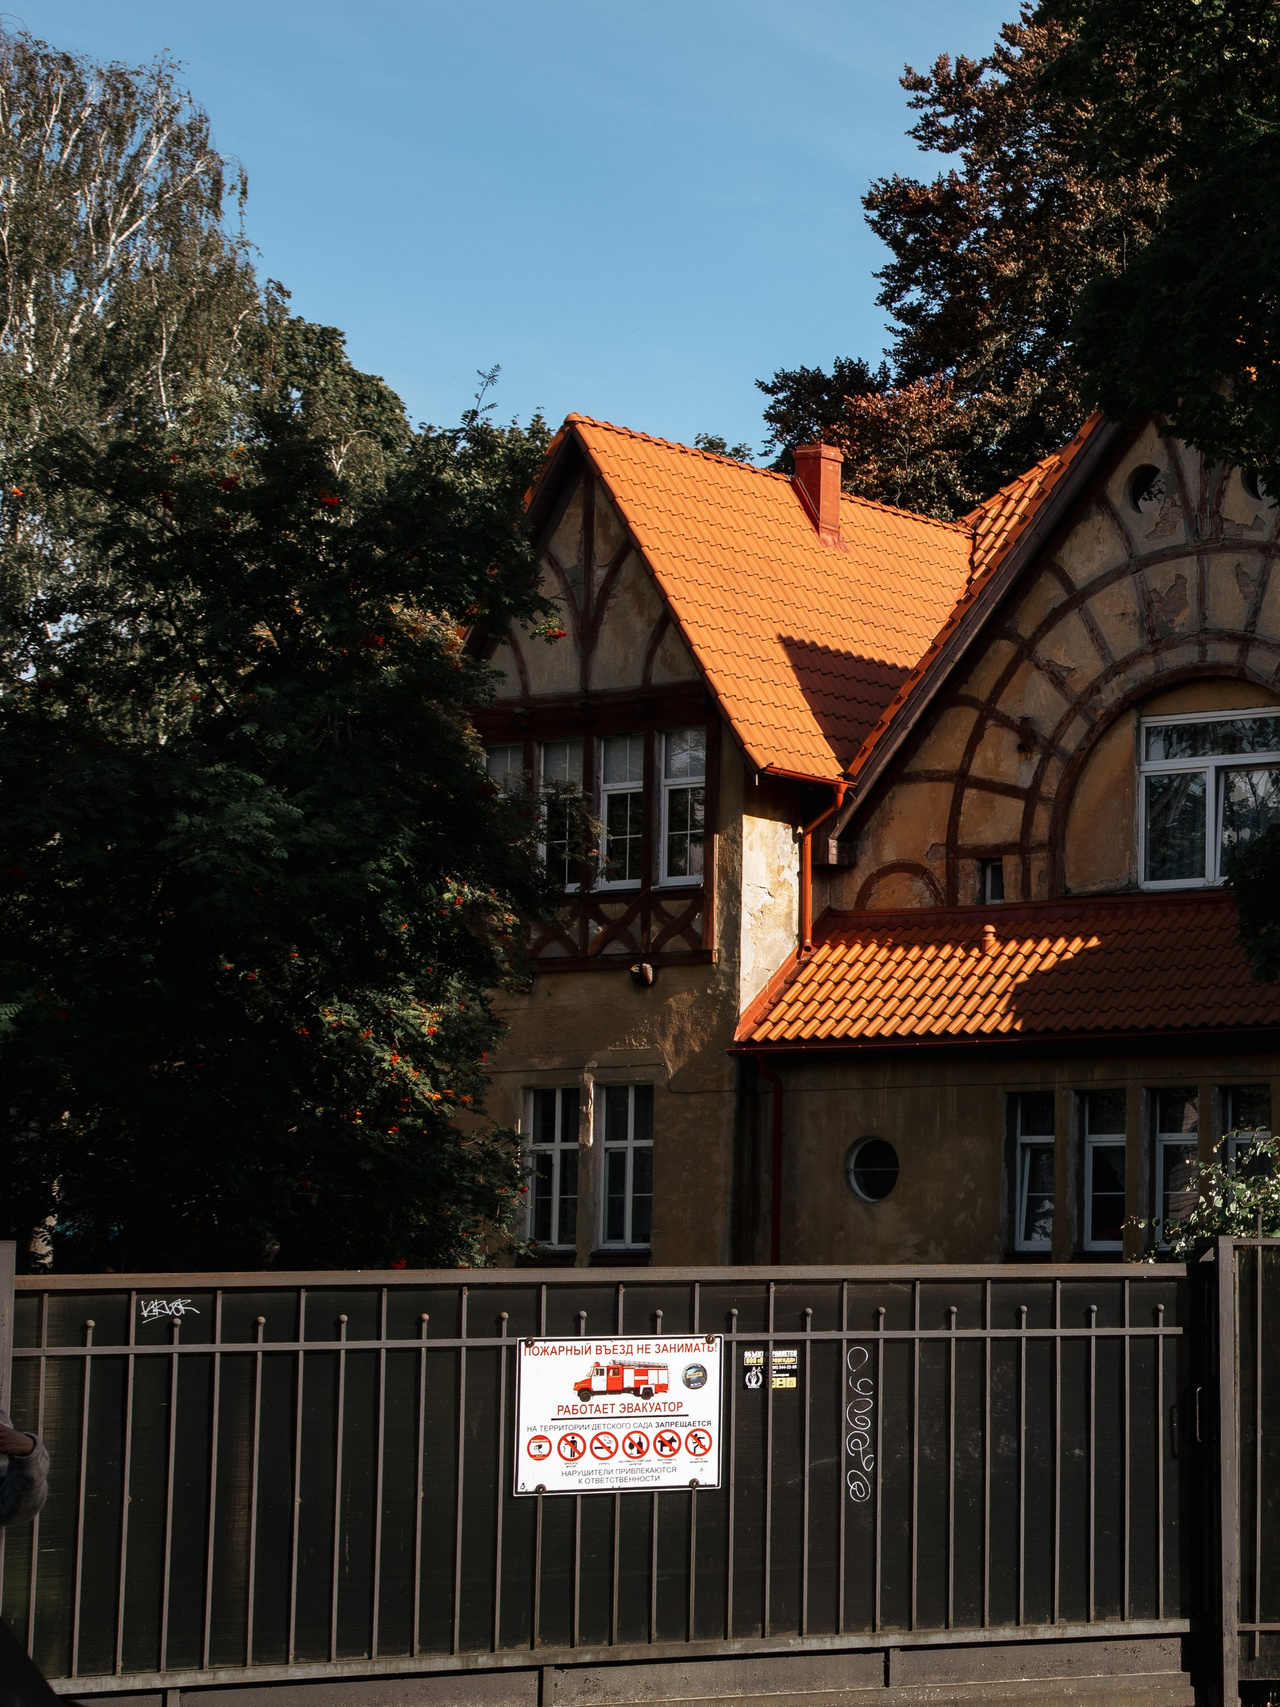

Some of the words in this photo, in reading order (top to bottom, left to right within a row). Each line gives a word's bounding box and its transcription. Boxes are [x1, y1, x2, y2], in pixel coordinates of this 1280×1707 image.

[524, 1343, 592, 1357] ПОЖАРНЫЙ
[596, 1344, 634, 1357] ВЪЕЗД
[636, 1344, 651, 1355] НЕ
[654, 1342, 718, 1354] ЗАНИМАТЬ!
[557, 1403, 616, 1416] РАБОТАЕТ
[619, 1401, 684, 1414] ЭВАКУАТОР
[539, 1424, 591, 1432] ТЕРРИТОРИИ
[591, 1422, 632, 1431] ДЕТСКОГО
[633, 1421, 654, 1429] САДА
[655, 1420, 712, 1429] ЗАПРЕЩАЕТСЯ
[561, 1468, 614, 1477] НАРУШИТЕЛИ
[615, 1466, 677, 1476] ПРИВЛЕКАЮТСЯ
[578, 1477, 584, 1485] К
[585, 1475, 661, 1484] ОТВЕТСТВЕННОСТИ
